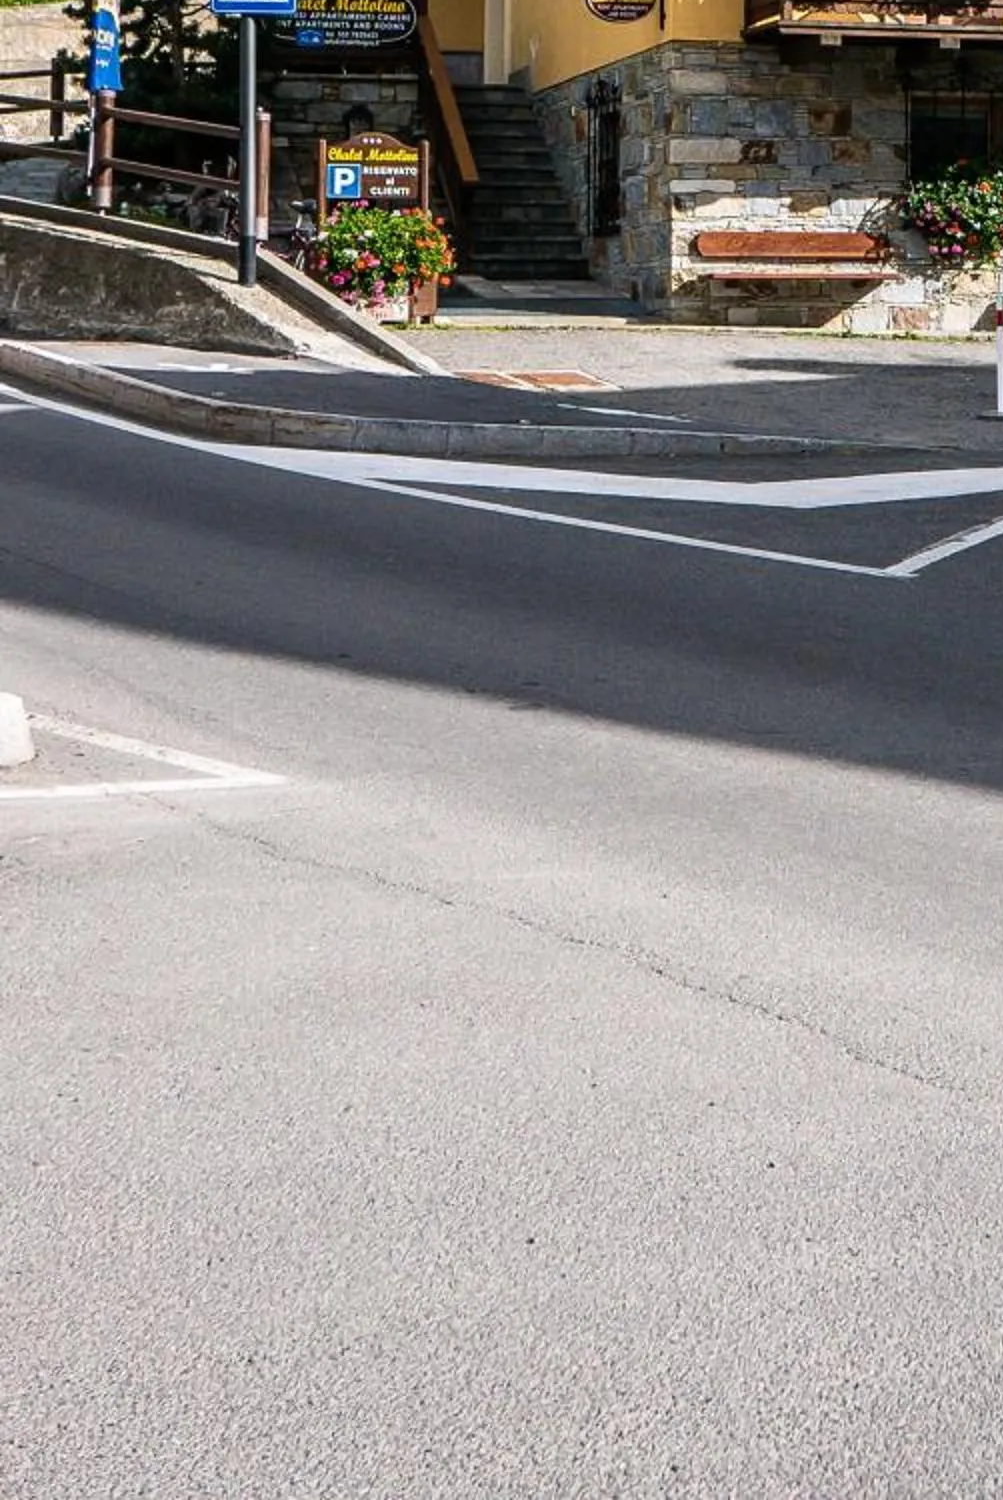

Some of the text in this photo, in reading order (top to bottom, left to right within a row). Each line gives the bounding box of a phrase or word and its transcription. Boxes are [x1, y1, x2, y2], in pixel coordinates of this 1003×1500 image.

[309, 11, 374, 20] APPARTAMENTI
[295, 20, 351, 29] APARTMENTS
[353, 22, 372, 30] AND
[374, 22, 405, 31] ROOMS
[363, 166, 417, 176] RISERVATO
[334, 167, 355, 194] P
[369, 187, 410, 195] CLIENTI
